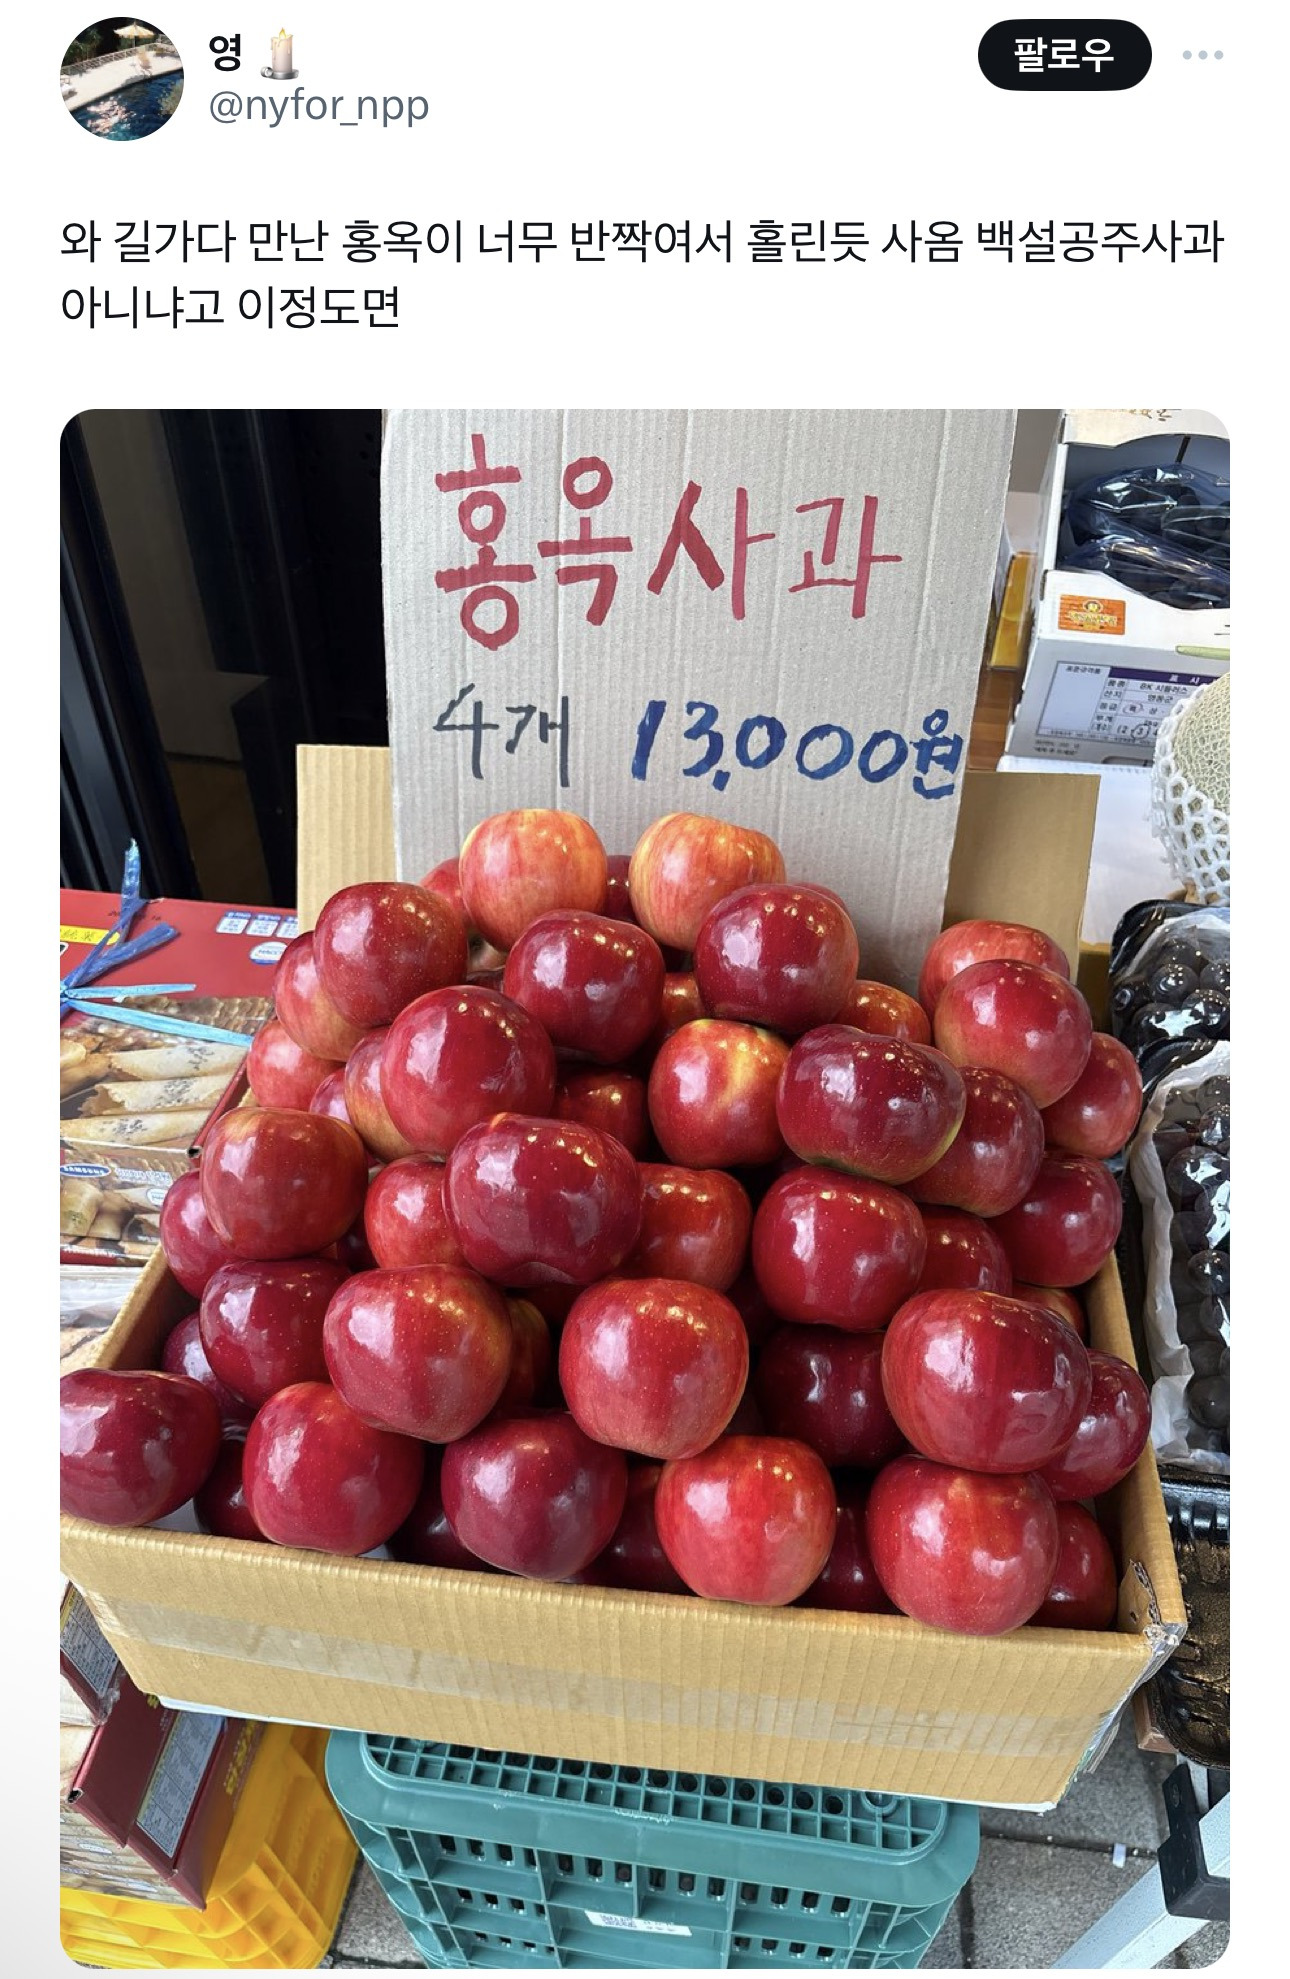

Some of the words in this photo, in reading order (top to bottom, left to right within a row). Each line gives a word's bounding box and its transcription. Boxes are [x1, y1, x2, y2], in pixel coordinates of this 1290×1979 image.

[435, 434, 903, 651] 홍옥사과
[432, 682, 570, 788] 4개
[631, 699, 963, 800] 13,000원
